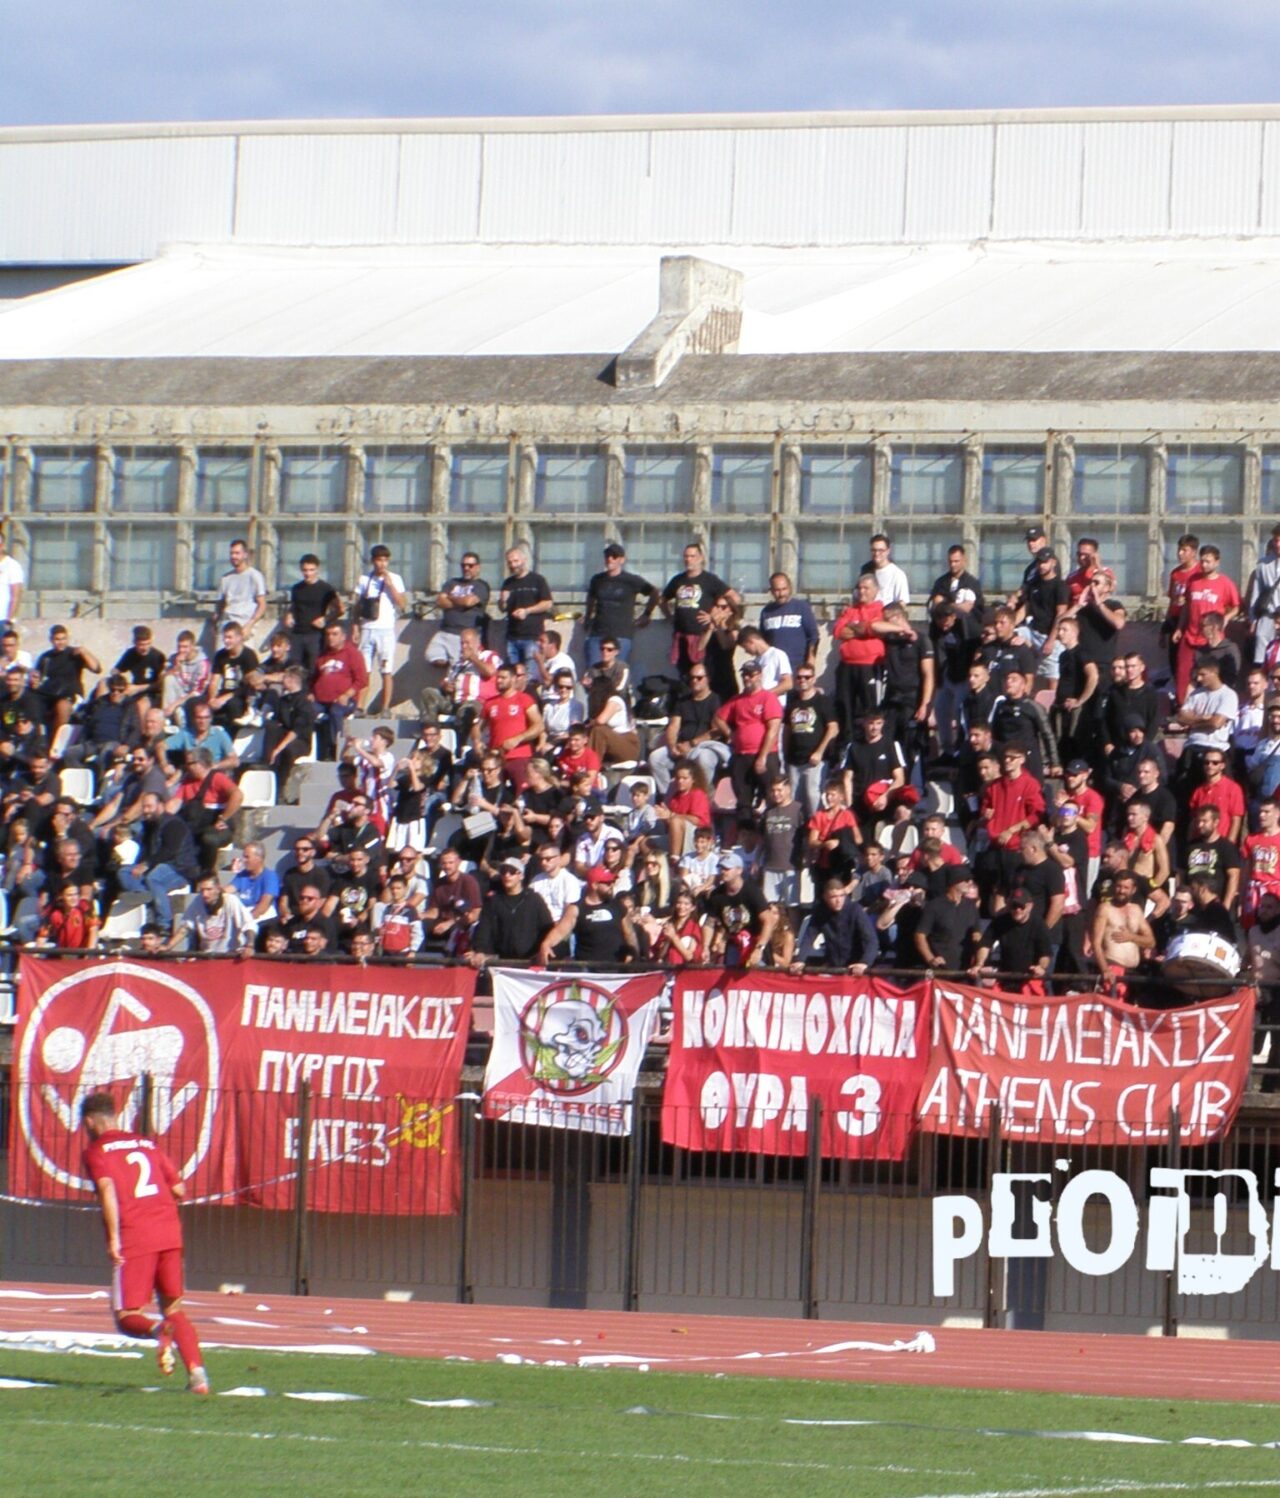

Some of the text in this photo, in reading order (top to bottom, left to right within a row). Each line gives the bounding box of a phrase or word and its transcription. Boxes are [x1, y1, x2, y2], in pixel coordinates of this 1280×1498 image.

[241, 984, 463, 1039] ΠΑΝΗΛΕΙΑΚΟΣ
[683, 987, 917, 1058] ΚΟΚΚΙΝΟΧΩΜΑ
[932, 988, 1240, 1068] ΠΑΝΗΛΕΙΑΚΟΣ
[257, 1050, 385, 1102] ΠΥΡΓΟΣ
[700, 1070, 882, 1136] ΘΥΡΑ 3
[919, 1066, 1232, 1138] ATHENS CLUB
[125, 1151, 160, 1199] 2
